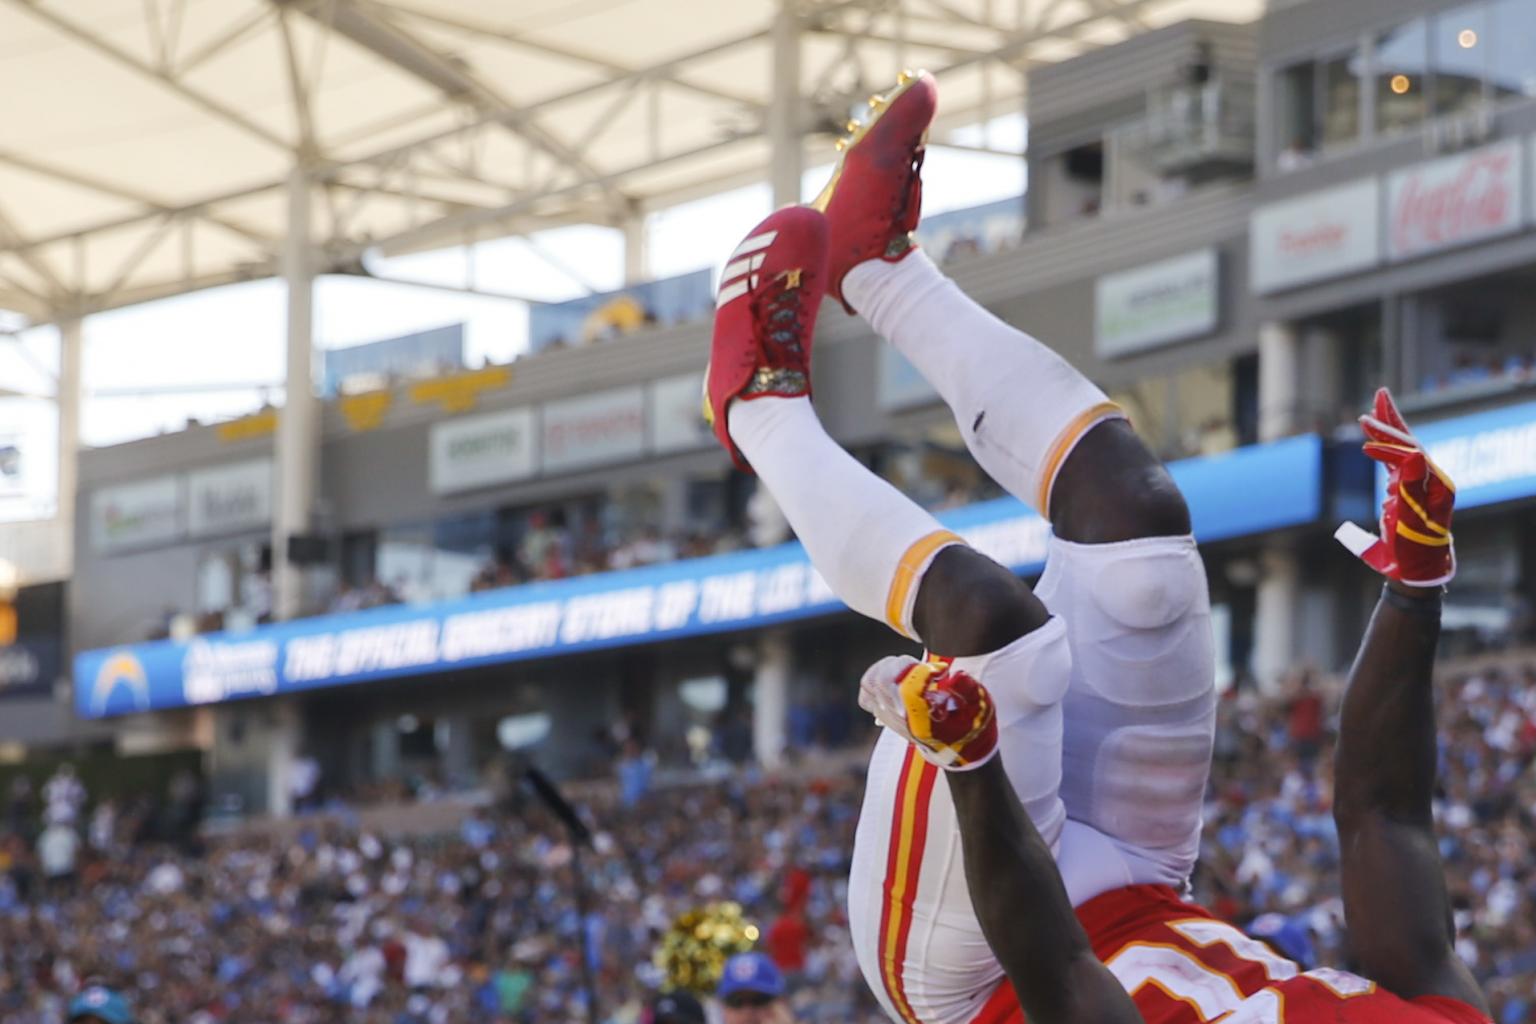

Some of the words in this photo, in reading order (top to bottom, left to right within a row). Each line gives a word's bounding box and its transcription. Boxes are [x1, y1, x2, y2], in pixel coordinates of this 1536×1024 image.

[284, 633, 336, 684] THE
[335, 617, 441, 677] OFFICIAL
[654, 578, 697, 631] OF
[701, 569, 757, 625] THE
